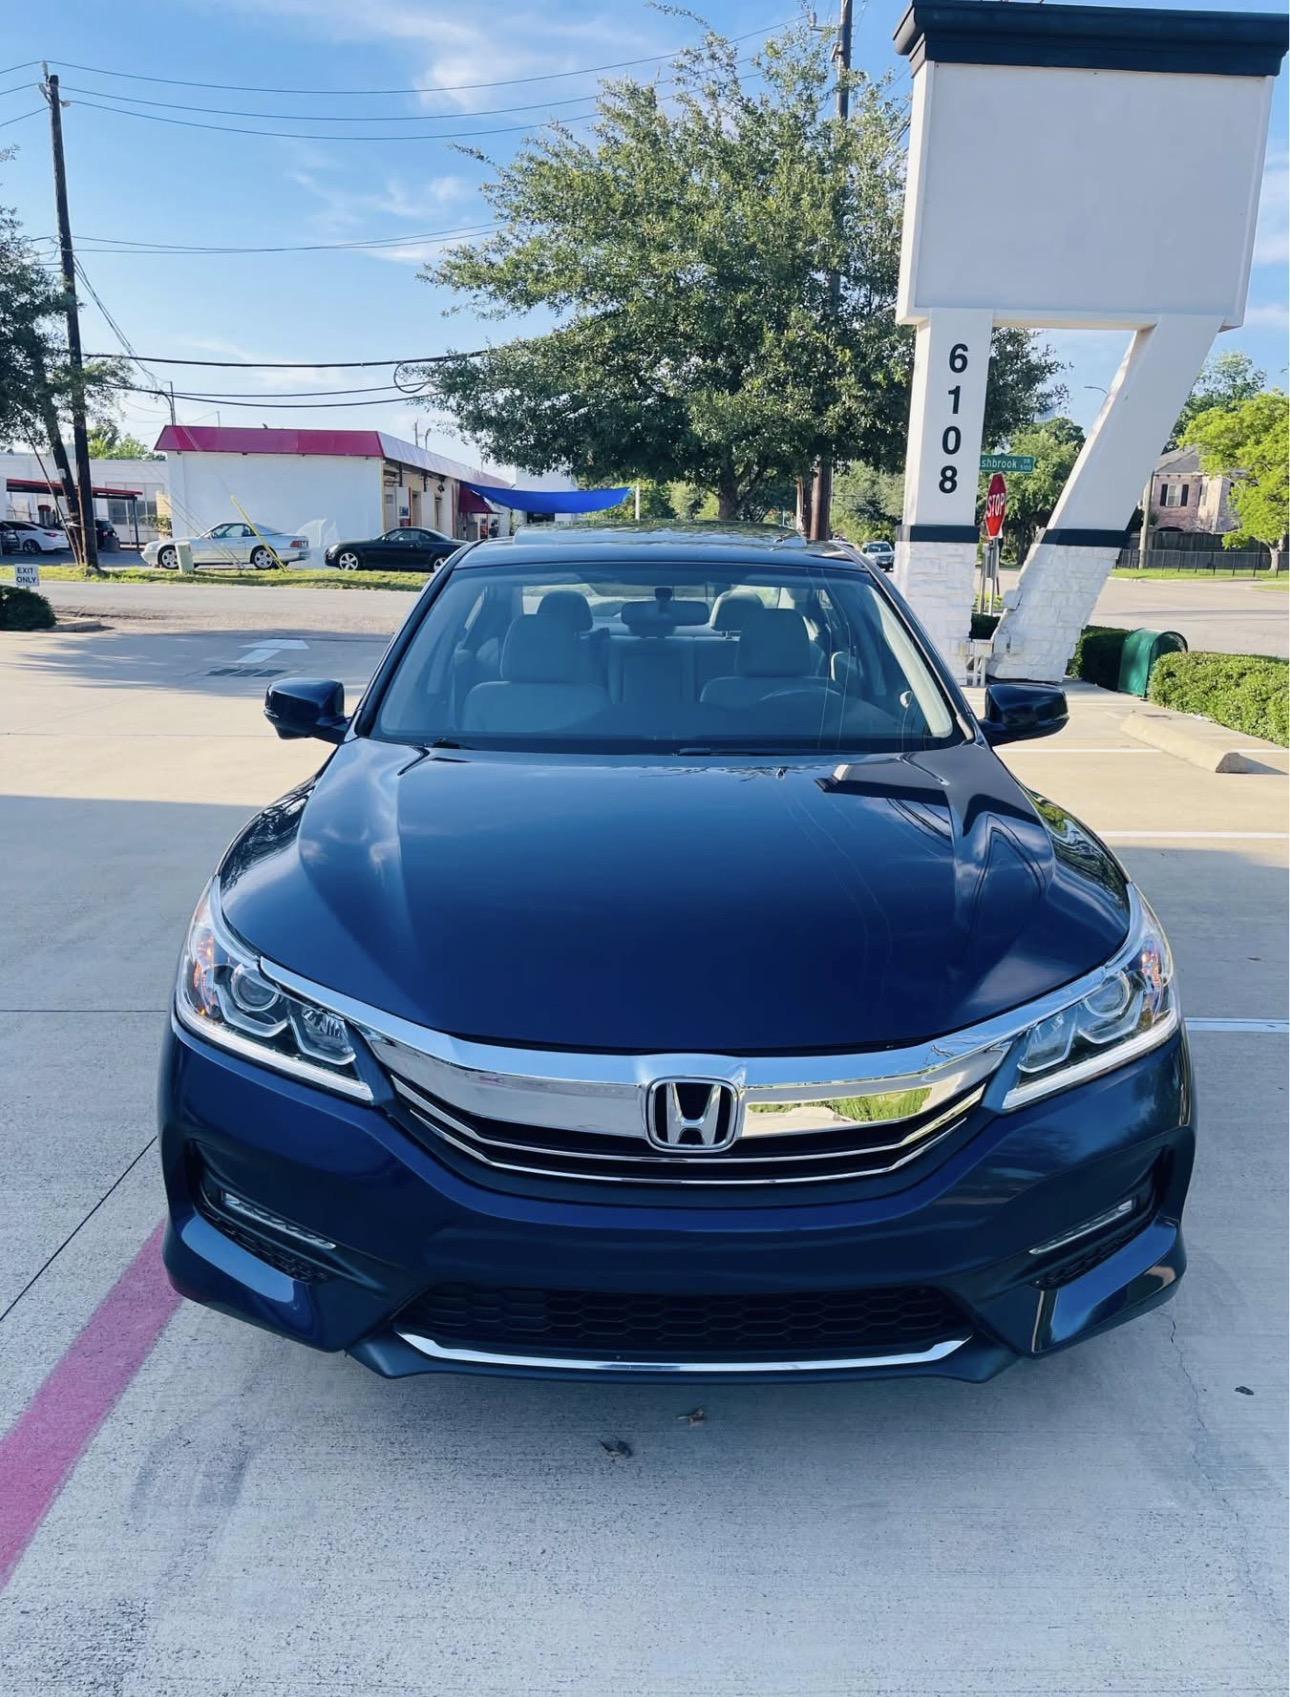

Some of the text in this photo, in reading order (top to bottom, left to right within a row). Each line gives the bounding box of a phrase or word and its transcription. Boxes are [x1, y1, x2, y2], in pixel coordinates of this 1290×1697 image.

[939, 343, 968, 493] 6108
[981, 458, 1017, 468] shbrook
[987, 492, 1005, 518] STOP
